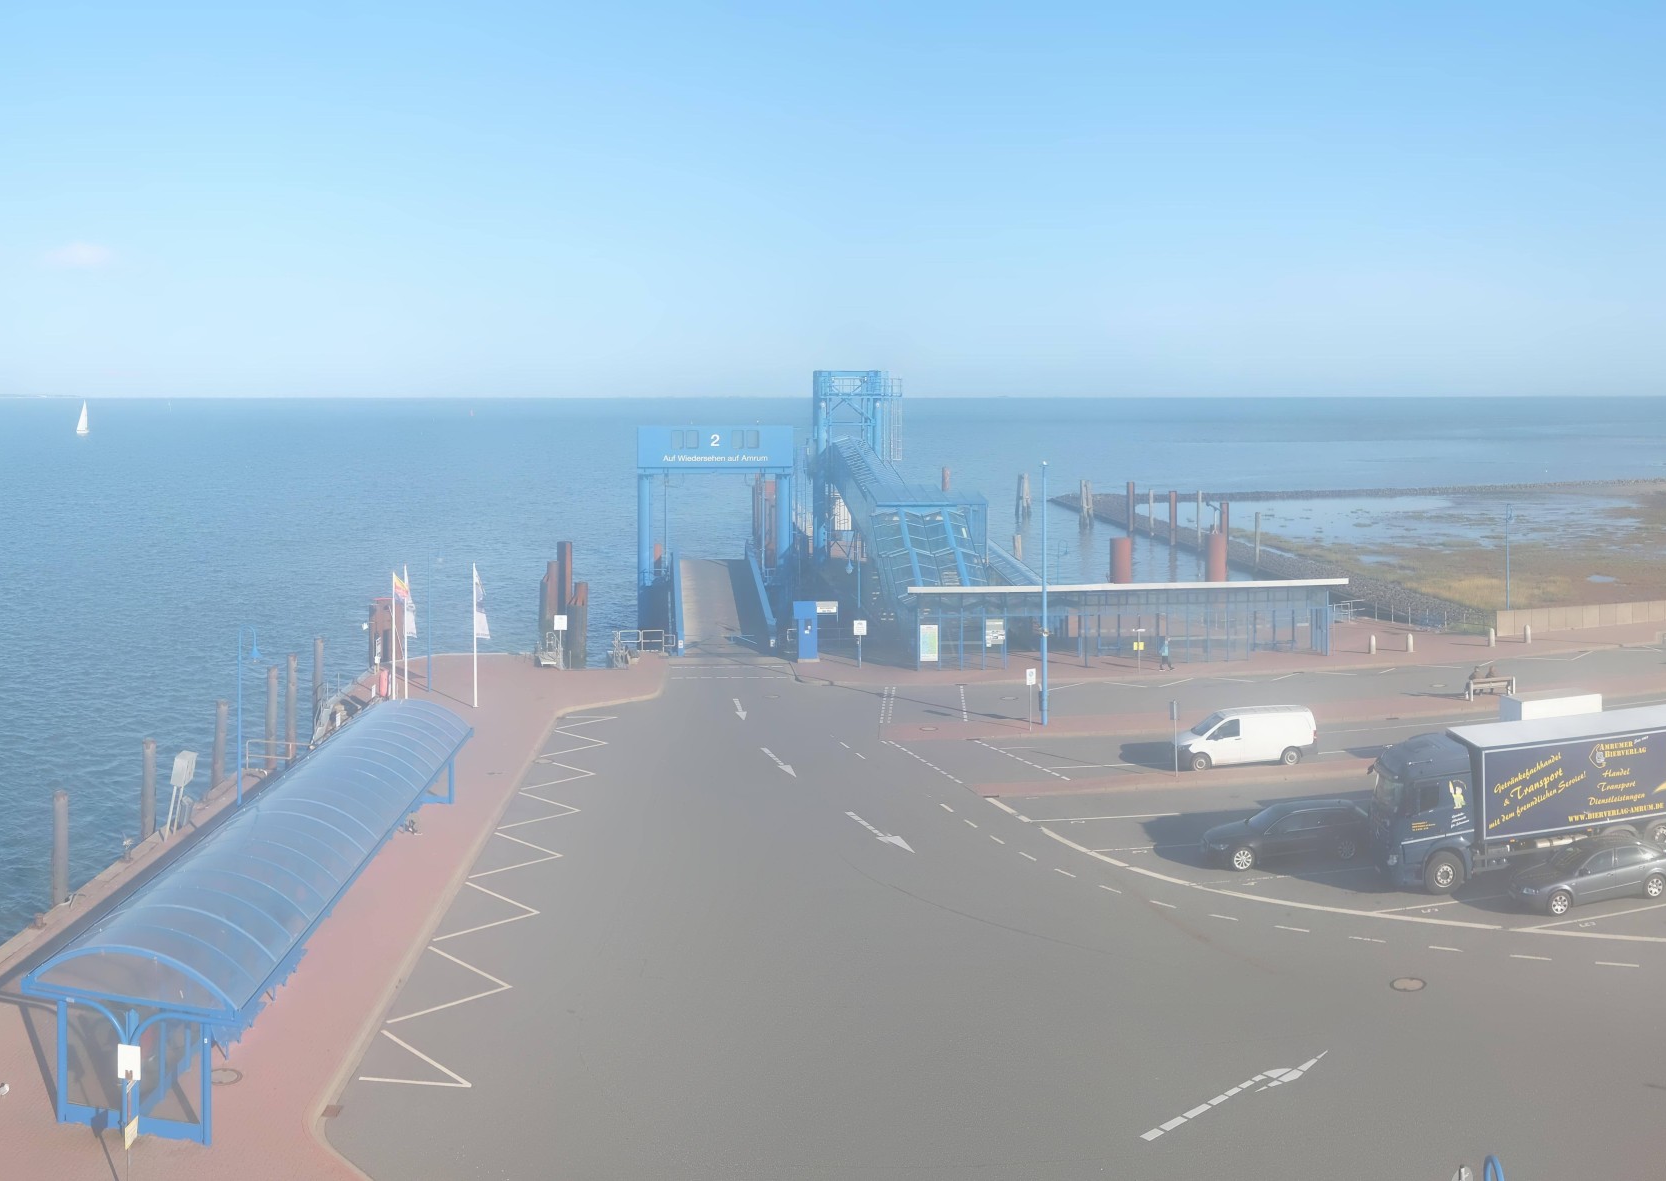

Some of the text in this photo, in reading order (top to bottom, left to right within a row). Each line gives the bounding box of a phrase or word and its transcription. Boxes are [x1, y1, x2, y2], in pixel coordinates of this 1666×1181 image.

[710, 433, 720, 447] 2
[663, 454, 676, 462] Auf
[677, 454, 726, 462] Wiedersehen
[727, 454, 740, 462] auf
[1599, 741, 1634, 751] AMRUMER
[1604, 747, 1647, 758] BIERVERLAG
[1493, 752, 1562, 795] Getränkefachhandel
[1602, 768, 1630, 778] Handel
[1503, 767, 1564, 807] & Transport
[1596, 780, 1636, 792] Transport
[1488, 818, 1501, 830] mit
[1501, 809, 1515, 823] dem
[1516, 788, 1558, 817] freundlichen
[1557, 771, 1587, 794] Service!
[1588, 793, 1646, 806] Dienstleistungen
[1568, 802, 1665, 823] WWW.BIERVERLAG-AMRUM.DE
